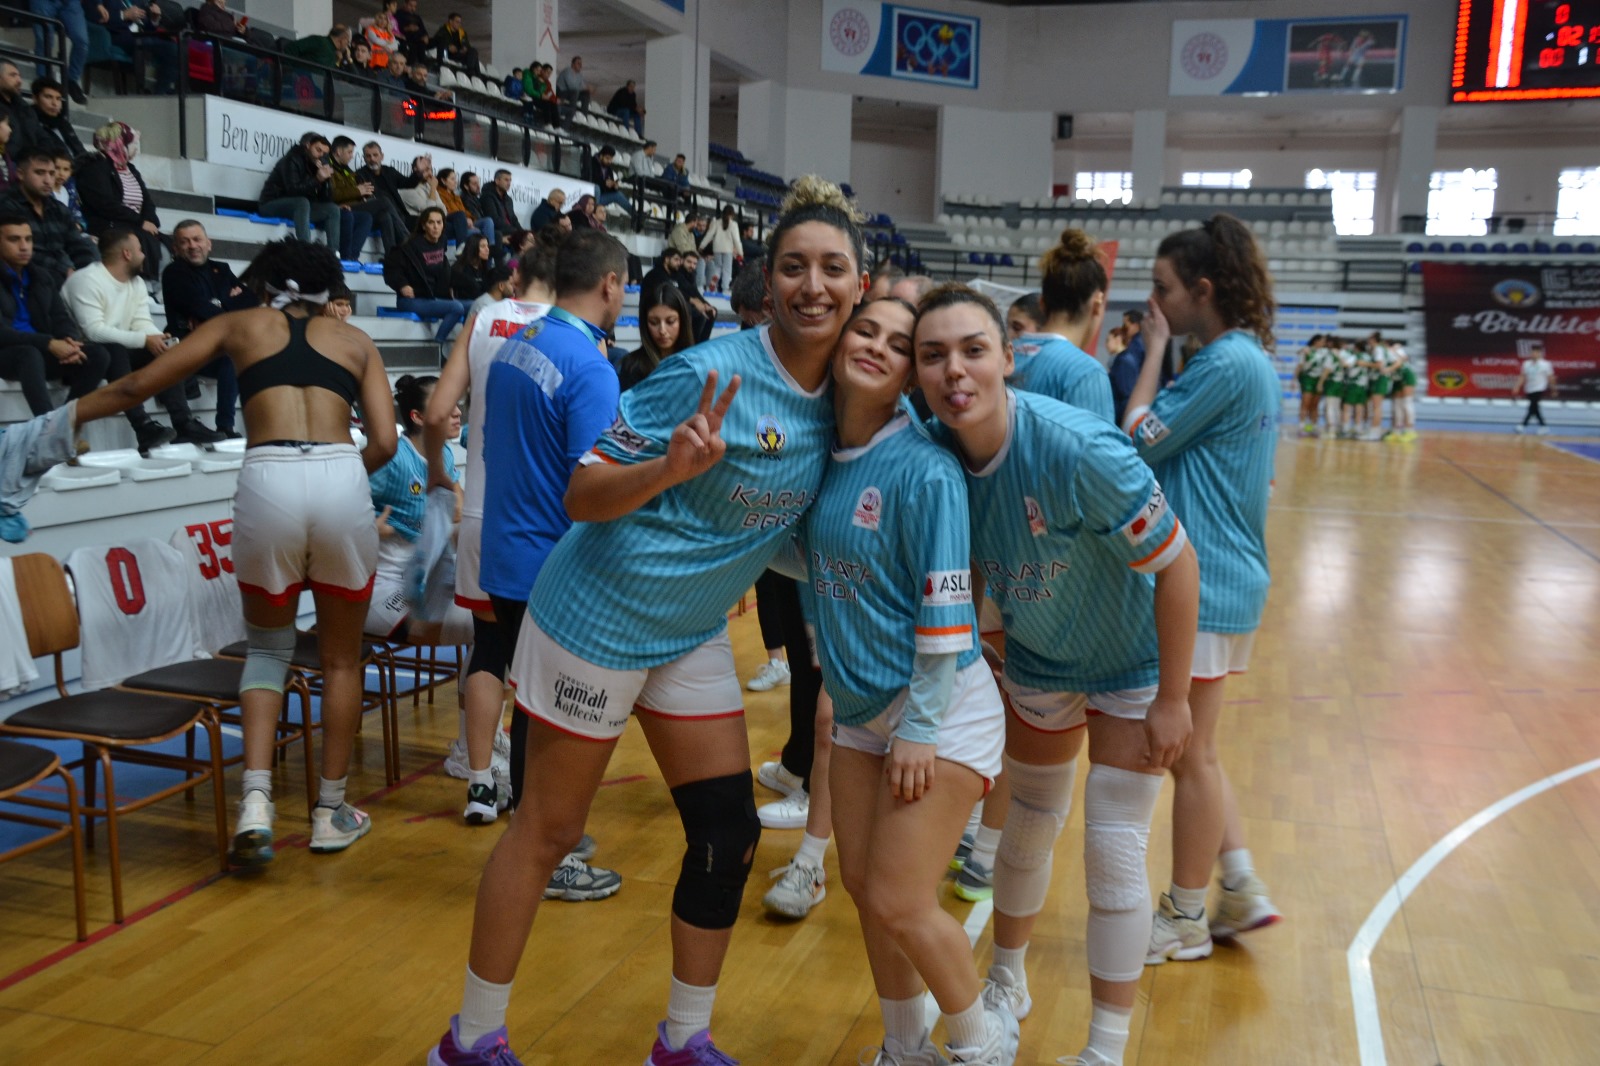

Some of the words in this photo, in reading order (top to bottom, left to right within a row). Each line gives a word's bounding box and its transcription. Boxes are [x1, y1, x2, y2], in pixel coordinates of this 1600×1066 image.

[221, 113, 248, 152] Ben
[728, 483, 818, 509] KARA
[184, 518, 236, 580] 35
[105, 547, 147, 615] 0
